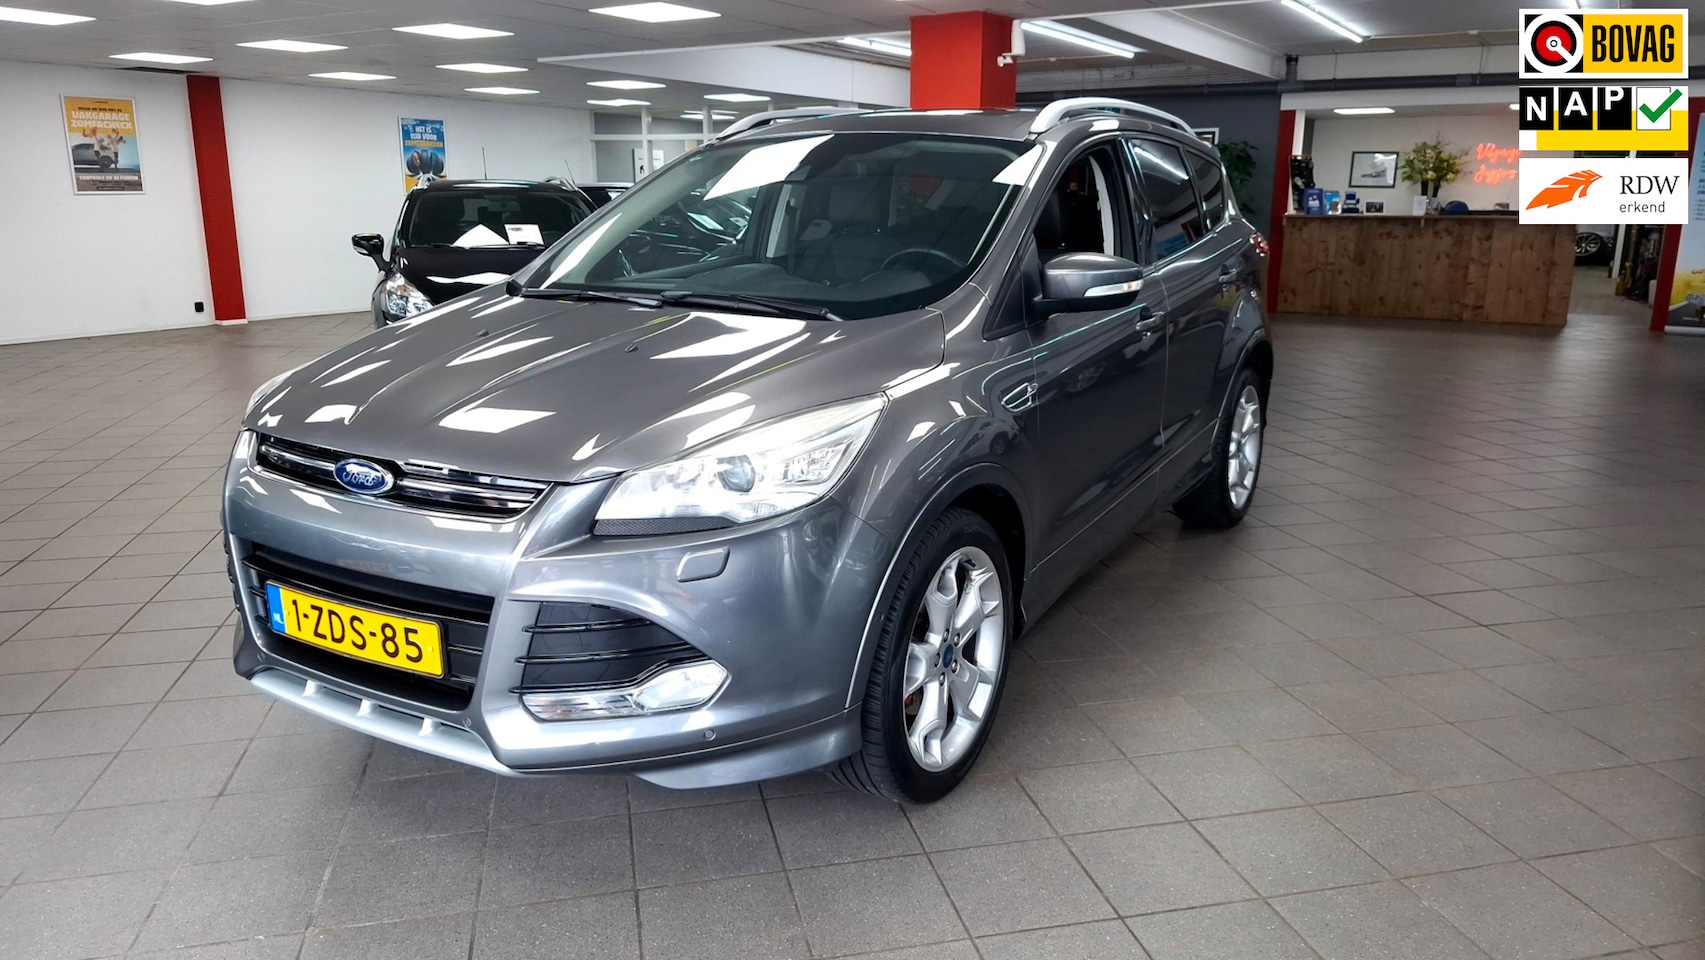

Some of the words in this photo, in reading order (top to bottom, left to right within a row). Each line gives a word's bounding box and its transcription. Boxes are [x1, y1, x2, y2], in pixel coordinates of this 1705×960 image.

[71, 111, 130, 121] VAKGARAGE
[71, 119, 132, 129] ZOMERCHECK
[342, 465, 379, 487] Ford
[273, 613, 284, 625] NL
[291, 599, 423, 663] 1-ZDS-85
